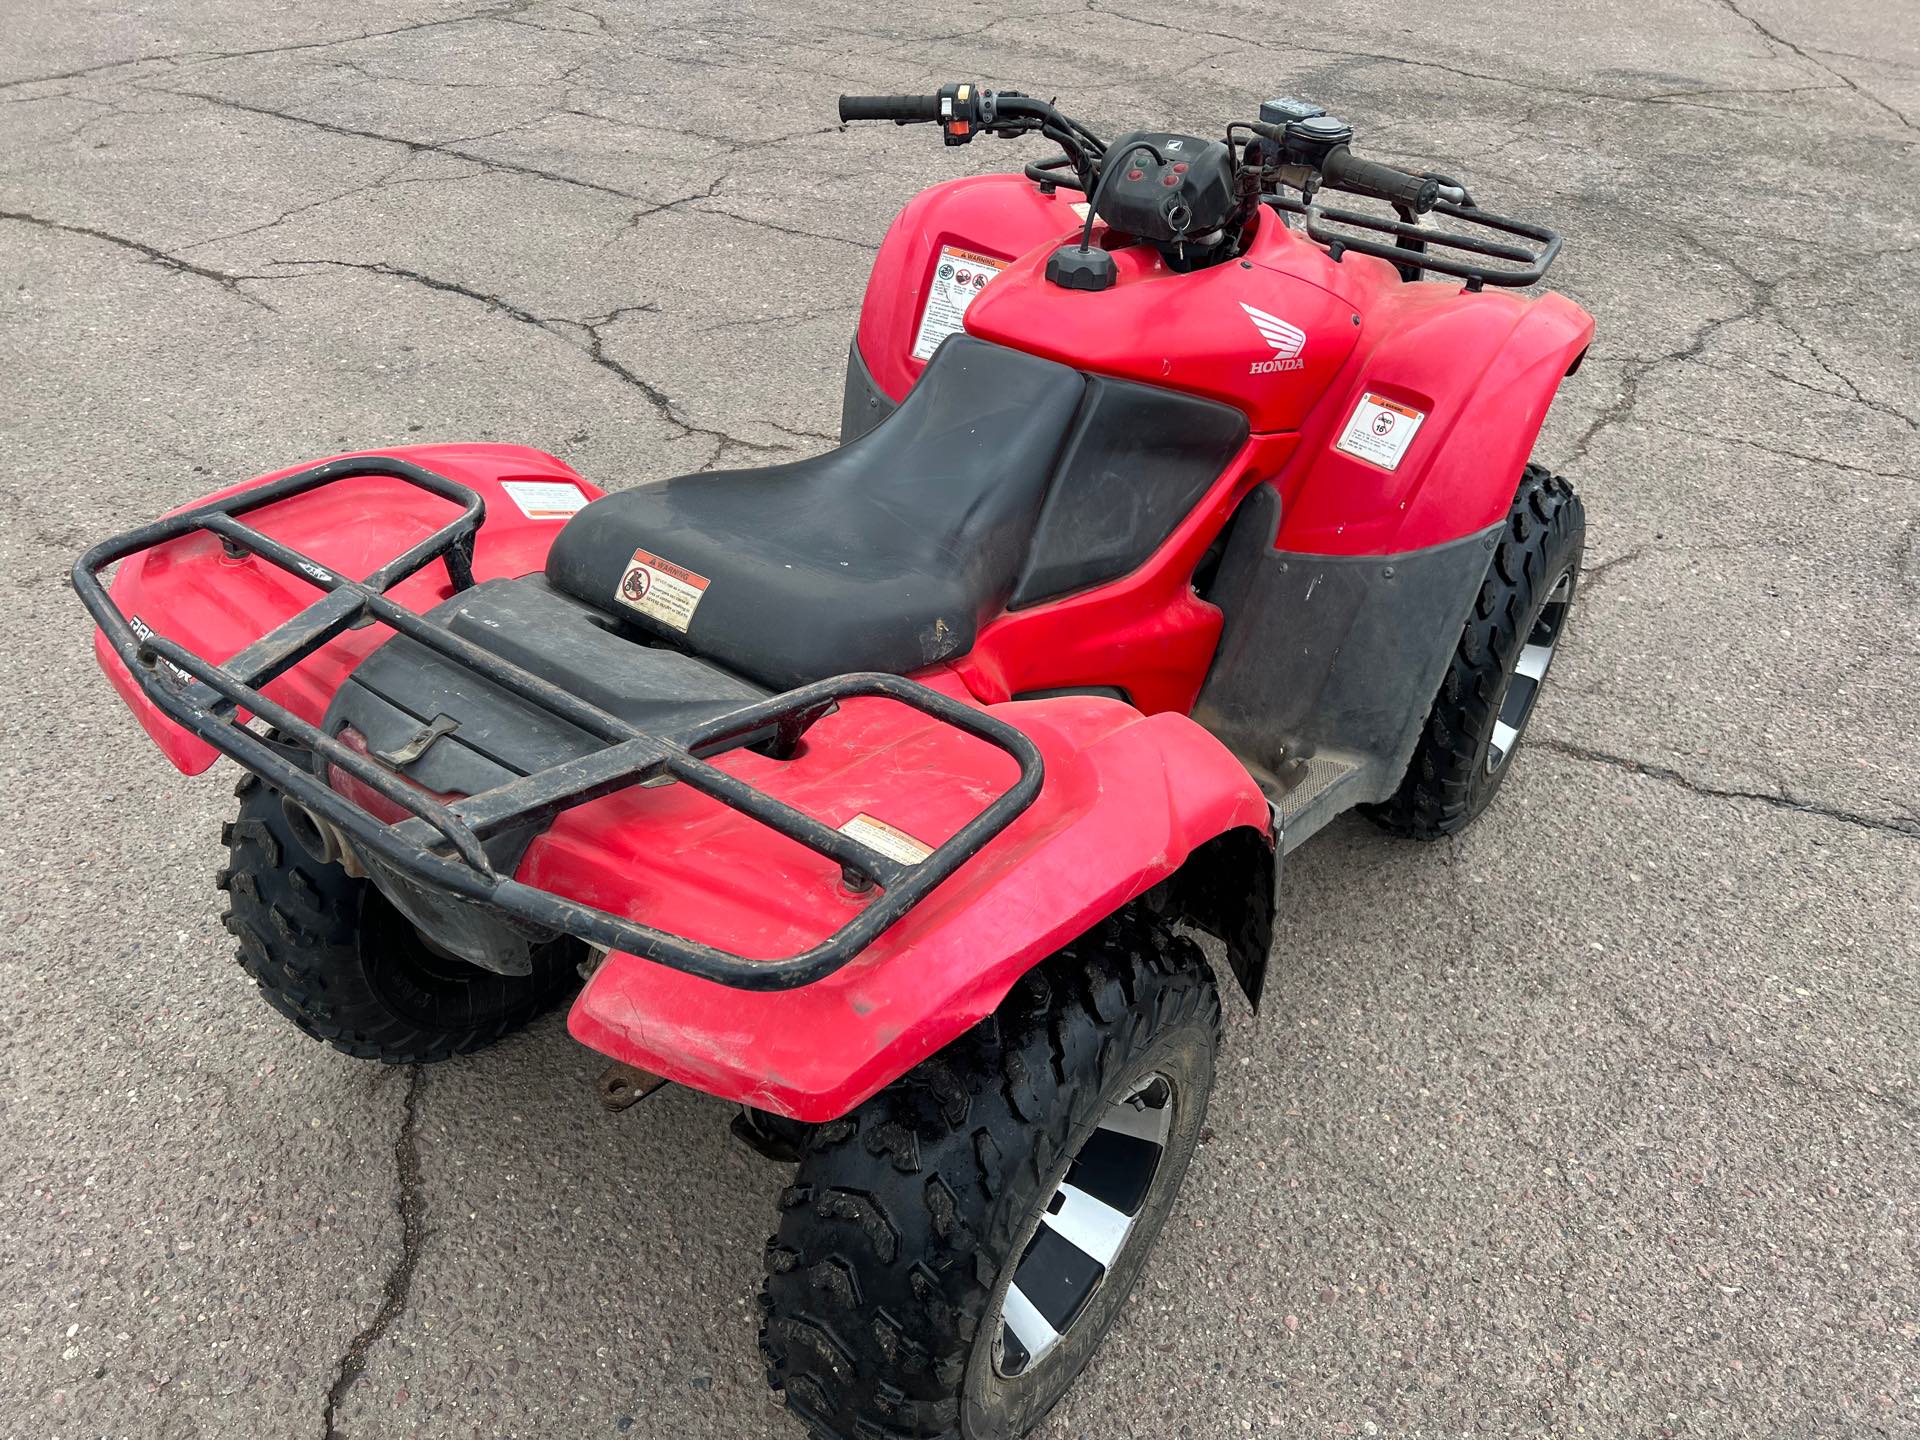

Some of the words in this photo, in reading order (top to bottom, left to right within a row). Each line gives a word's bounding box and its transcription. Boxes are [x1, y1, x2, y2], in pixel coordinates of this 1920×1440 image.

[967, 253, 996, 267] WARNING
[1249, 358, 1305, 375] HONDA
[1377, 416, 1393, 426] UNDER
[1376, 424, 1386, 433] 16
[657, 562, 690, 581] WARNING
